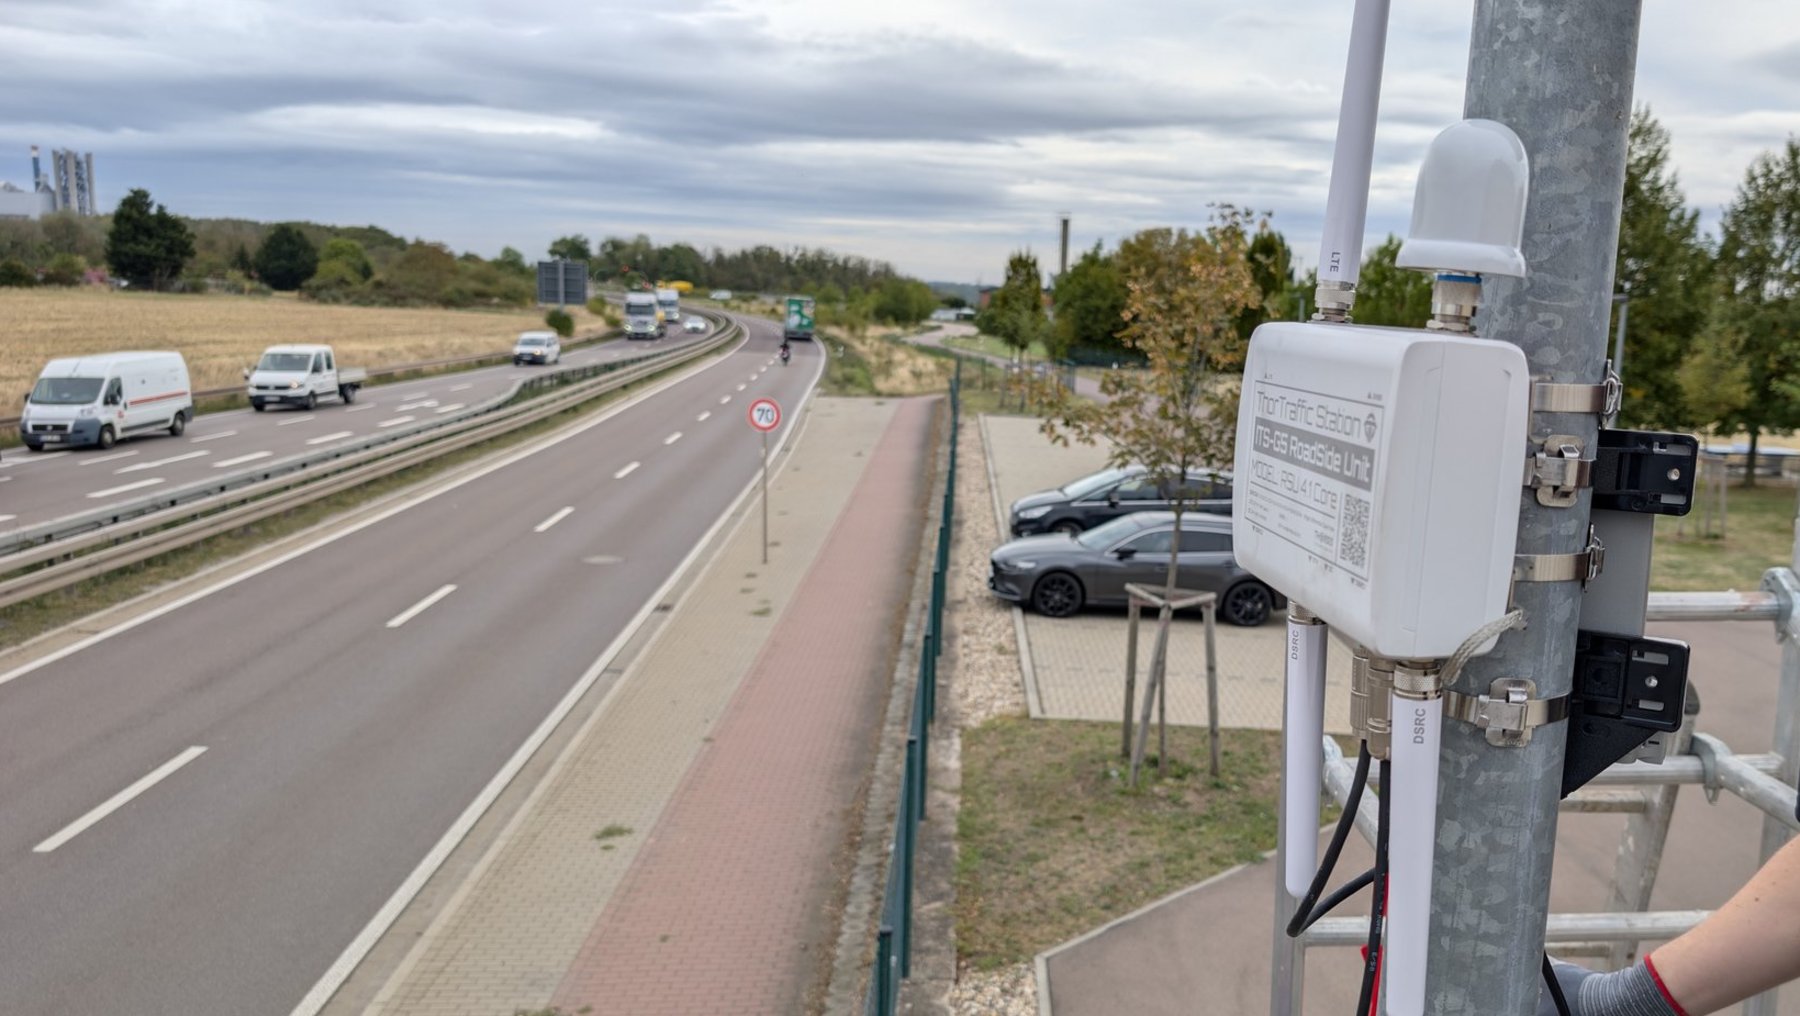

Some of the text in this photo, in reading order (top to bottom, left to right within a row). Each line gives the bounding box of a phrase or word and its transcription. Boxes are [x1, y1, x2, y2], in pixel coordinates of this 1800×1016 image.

[1329, 251, 1341, 273] LTE
[756, 407, 775, 424] 70
[1315, 404, 1361, 439] Station
[1255, 424, 1371, 483] ITS-G5 RoadSide Unit
[1313, 481, 1337, 510] Core
[1290, 629, 1300, 660] DSRC
[1412, 707, 1427, 745] DSRC
